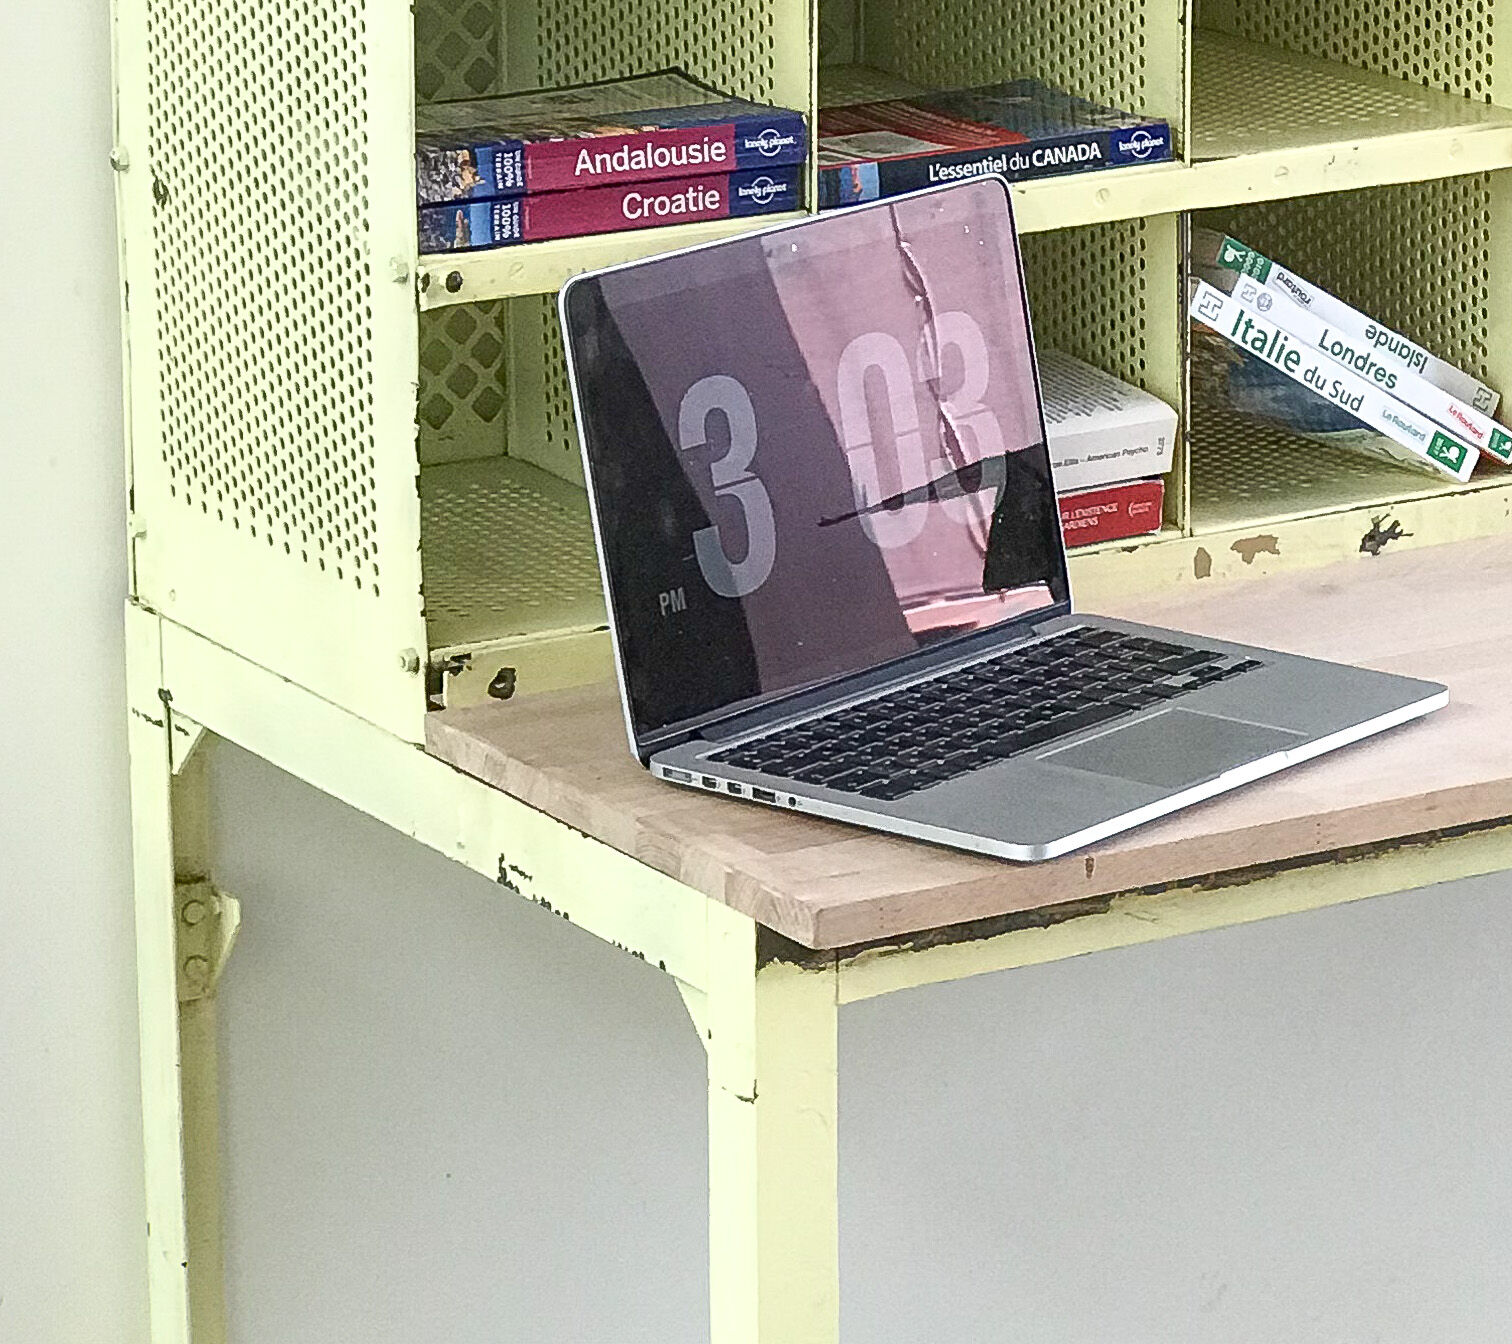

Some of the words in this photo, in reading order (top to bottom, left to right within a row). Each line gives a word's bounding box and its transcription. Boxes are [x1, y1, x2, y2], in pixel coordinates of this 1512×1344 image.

[503, 152, 515, 187] 100%
[574, 137, 727, 176] Andalousie
[929, 154, 1007, 181] L'essentiel
[1009, 152, 1029, 170] du
[1032, 142, 1102, 166] CANADA
[501, 204, 511, 238] 100%
[622, 185, 720, 220] Croatie
[1276, 272, 1311, 304] routard
[1230, 309, 1301, 375] Italie
[1303, 367, 1328, 390] du
[1330, 380, 1365, 412] Sud
[1317, 329, 1398, 389] Londres
[1364, 324, 1428, 375] Islande
[677, 374, 777, 598] 3
[659, 585, 687, 617] PM
